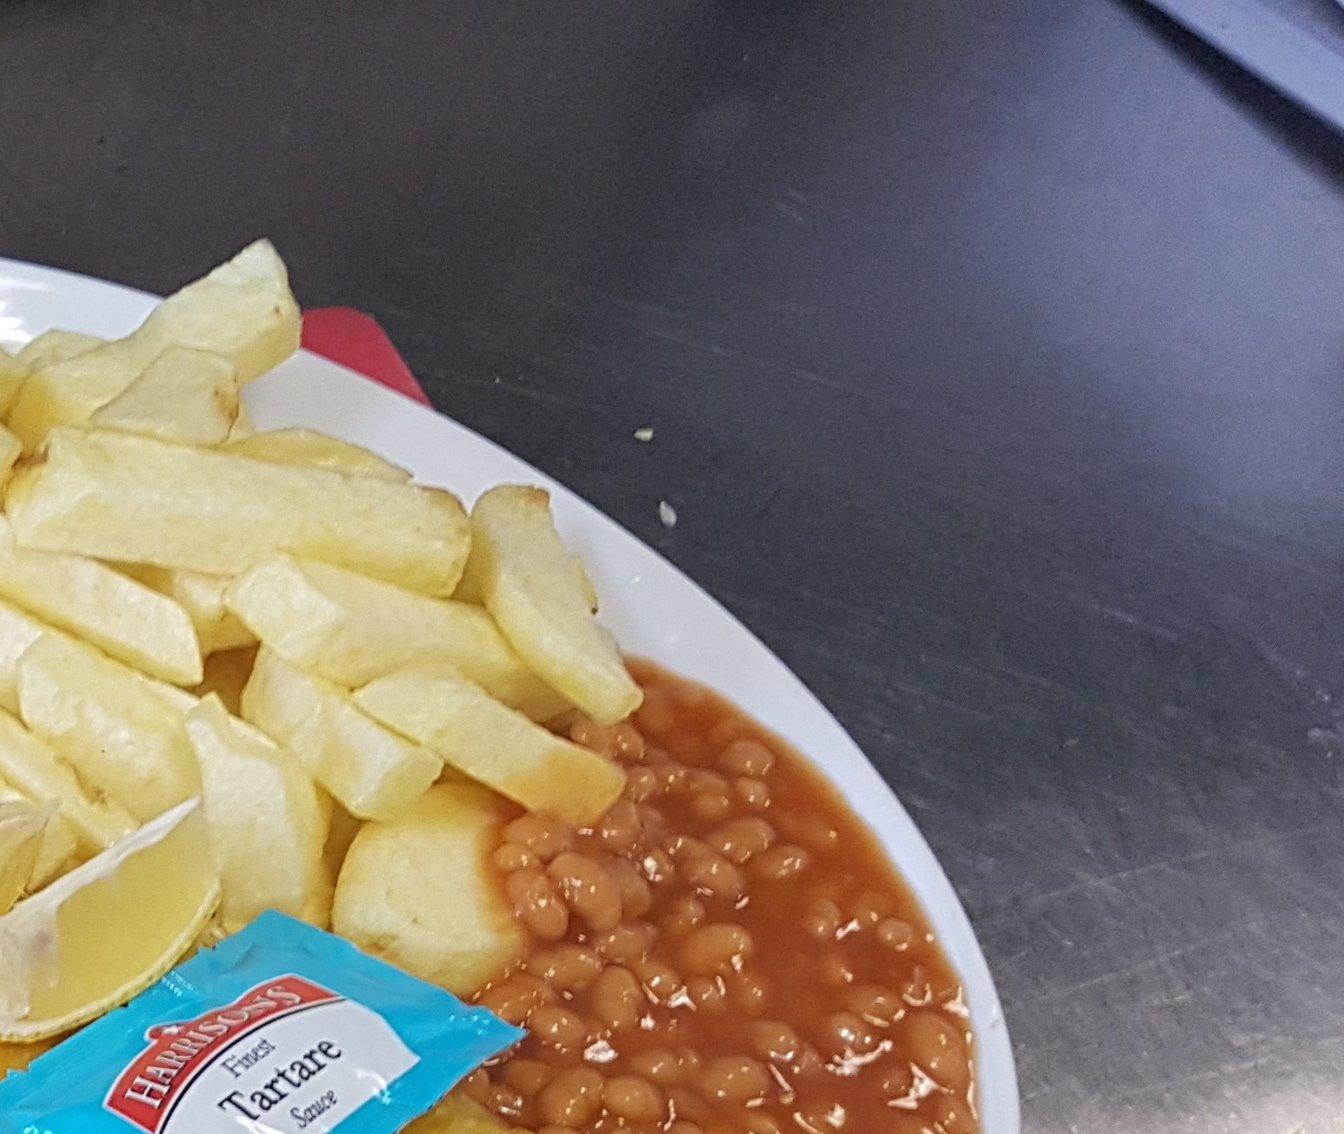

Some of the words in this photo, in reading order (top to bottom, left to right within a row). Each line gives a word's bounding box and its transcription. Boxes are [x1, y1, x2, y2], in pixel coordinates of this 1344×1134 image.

[125, 985, 303, 1109] HARRISONS
[221, 1037, 277, 1079] Finest
[217, 1039, 343, 1122] Tartare
[290, 1089, 338, 1130] Sauce
